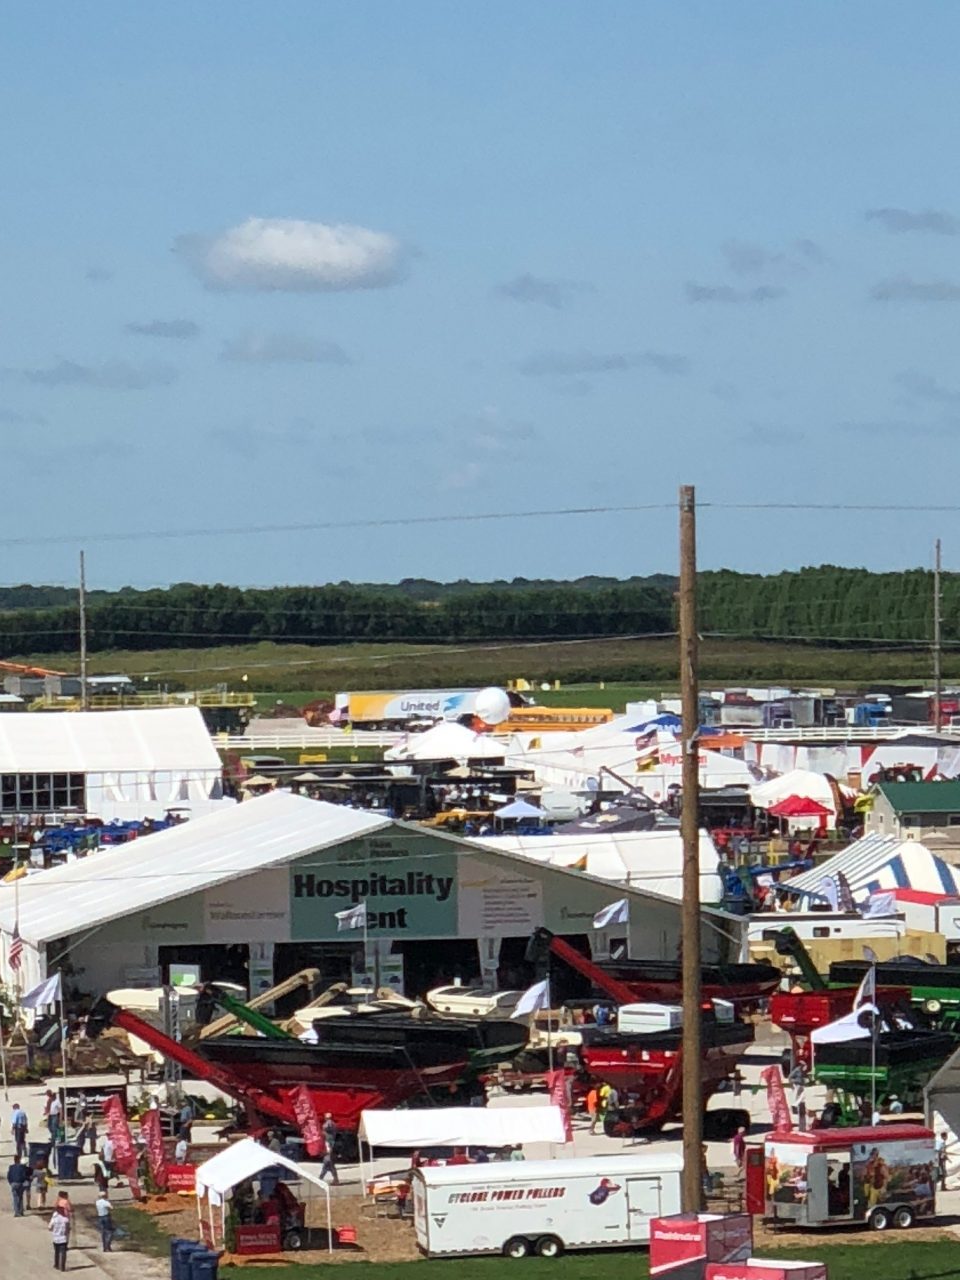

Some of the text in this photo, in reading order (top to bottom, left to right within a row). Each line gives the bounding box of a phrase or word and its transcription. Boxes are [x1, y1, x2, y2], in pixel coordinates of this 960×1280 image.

[400, 701, 440, 712] United
[294, 871, 454, 902] Hospitality
[490, 1189, 524, 1201] POWER
[525, 1186, 566, 1200] PULLERS
[654, 1230, 701, 1242] Mahindra
